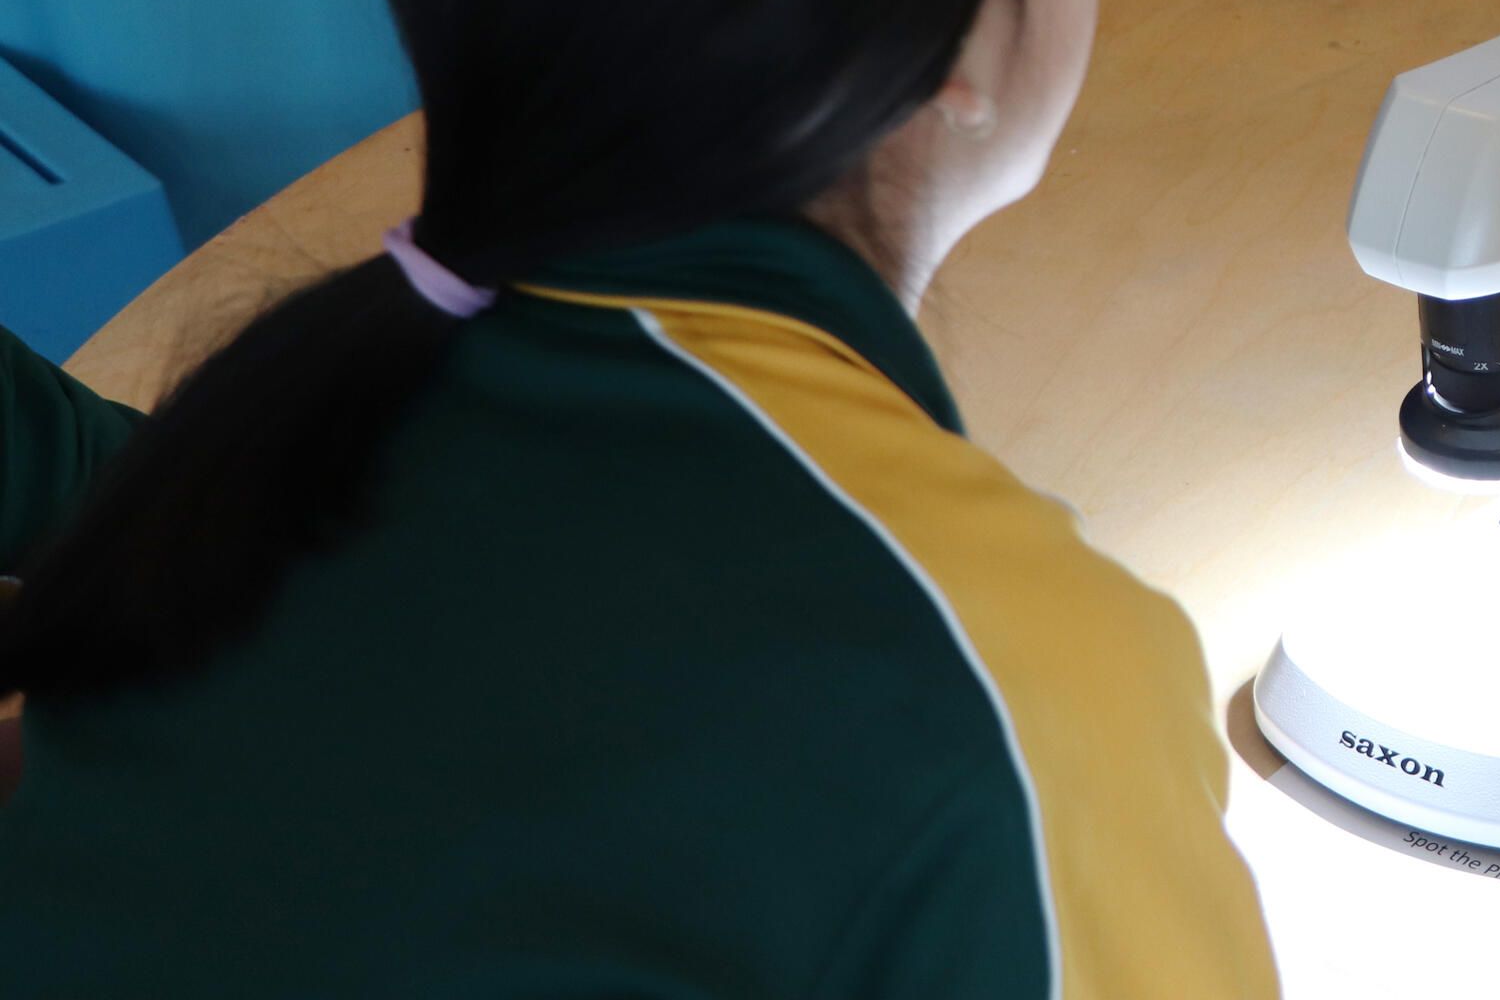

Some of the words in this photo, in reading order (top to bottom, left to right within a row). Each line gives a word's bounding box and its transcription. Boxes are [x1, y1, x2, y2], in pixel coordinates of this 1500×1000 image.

[1473, 362, 1488, 371] 2X
[1339, 730, 1445, 788] saxon
[1402, 831, 1448, 856] Spot
[1449, 849, 1481, 870] the
